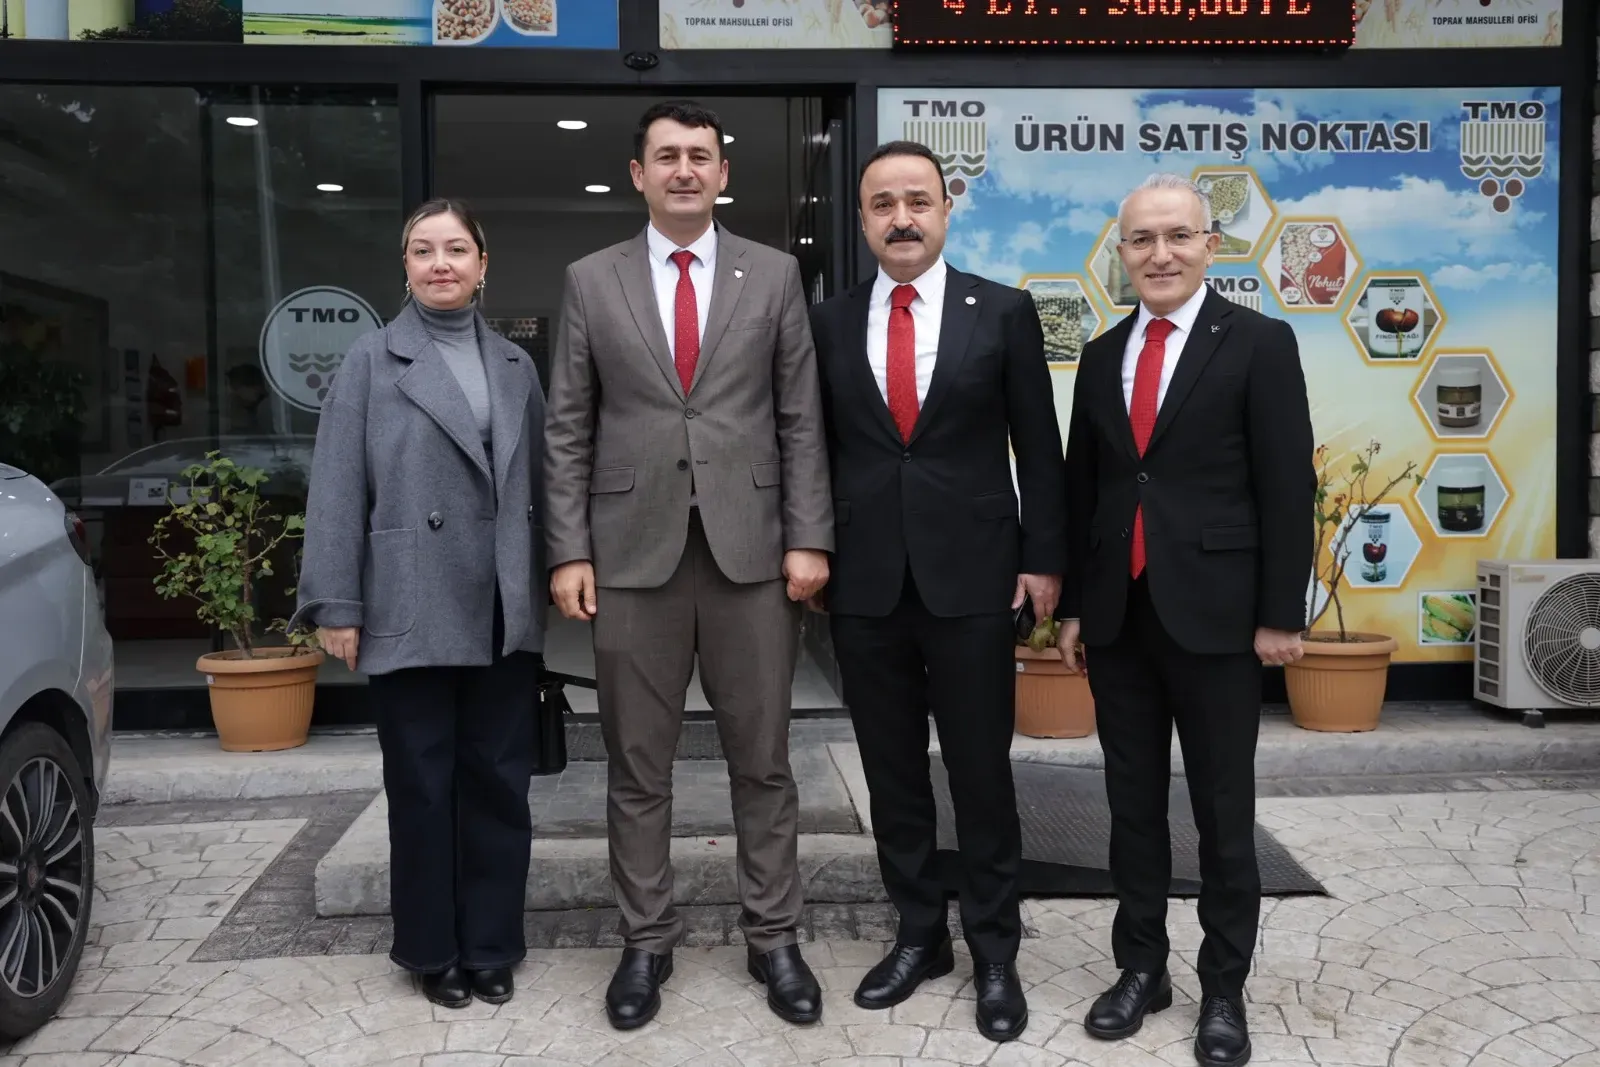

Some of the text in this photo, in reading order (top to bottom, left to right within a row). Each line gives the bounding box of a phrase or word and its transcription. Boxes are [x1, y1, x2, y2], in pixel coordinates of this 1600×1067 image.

[685, 16, 793, 27] TOPRAK MAHSULLERİ OFİSİ
[1432, 13, 1538, 26] TOPRAK MAHSULLERİ OFİSİ
[902, 100, 986, 118] TMO
[1462, 102, 1544, 119] TMO
[1014, 115, 1430, 159] ÜRÜN SATIŞ NOKTASI
[1203, 277, 1260, 293] MO
[287, 307, 360, 323] TMO
